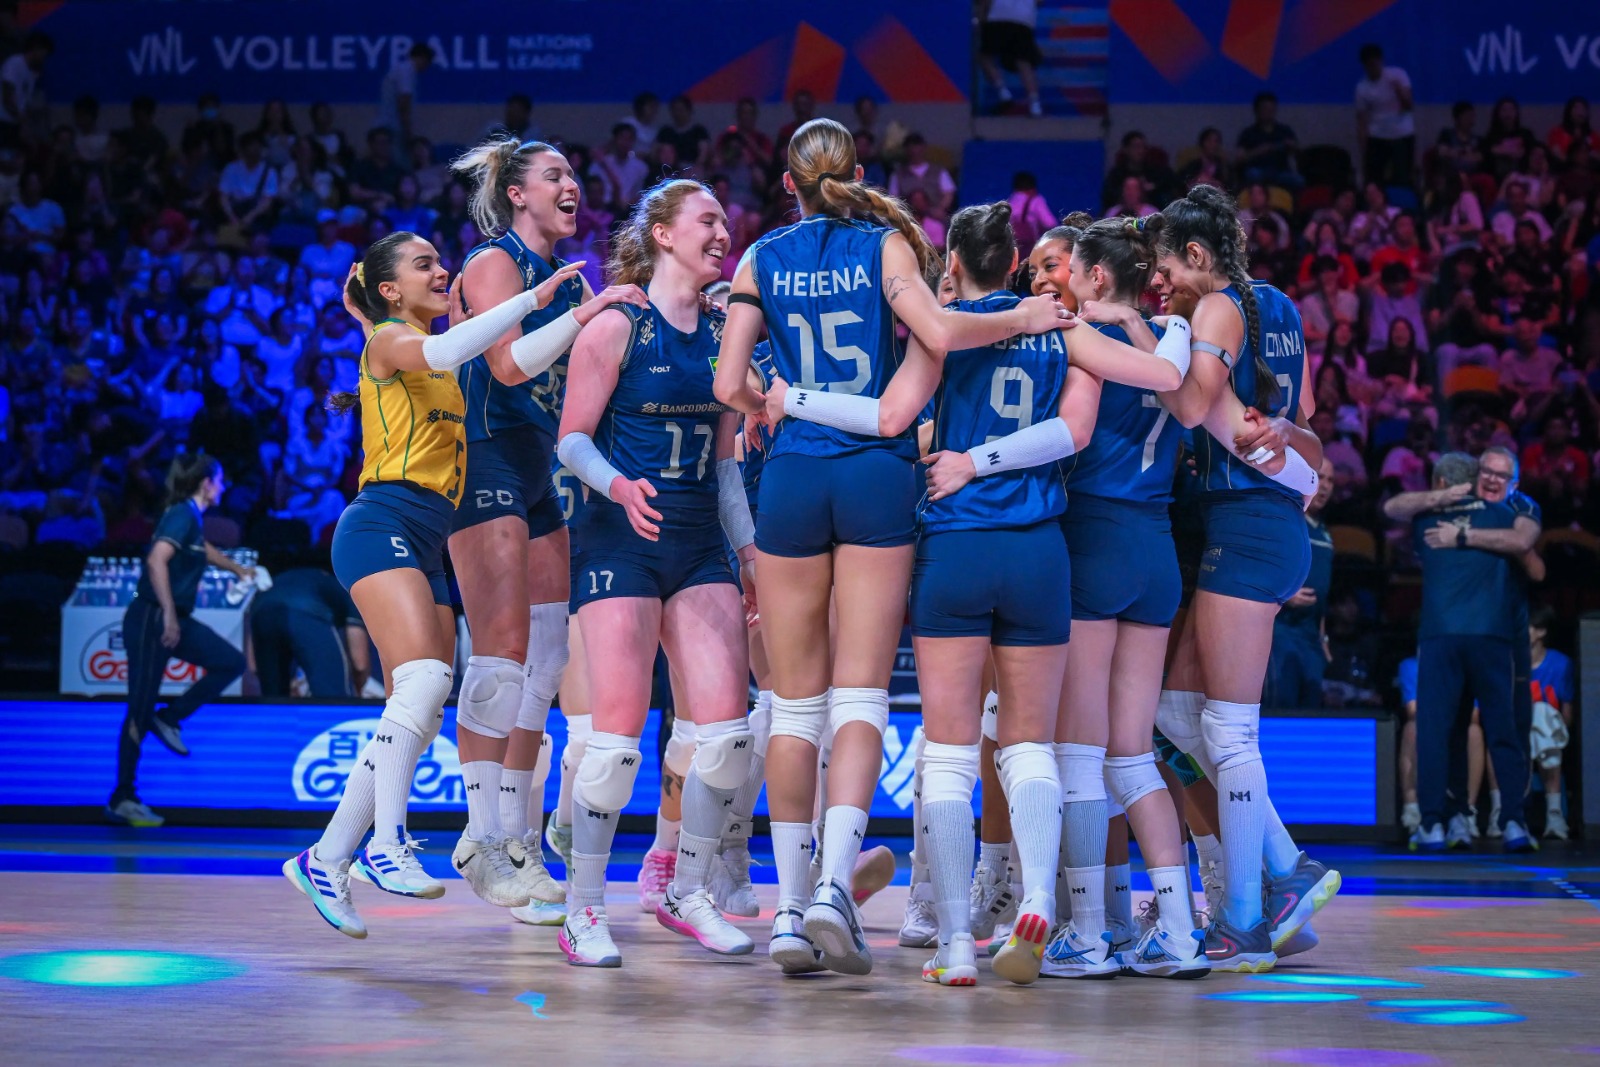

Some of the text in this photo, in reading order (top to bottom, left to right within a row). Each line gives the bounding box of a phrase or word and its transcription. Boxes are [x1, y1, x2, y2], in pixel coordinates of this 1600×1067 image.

[508, 35, 593, 50] NATIONS
[1464, 23, 1539, 75] VNL
[128, 26, 196, 75] VNL
[508, 54, 581, 70] LEAGUE
[772, 264, 872, 298] HELENA
[788, 310, 872, 396] 15
[990, 366, 1034, 431] 9
[660, 422, 714, 481] 17
[475, 489, 514, 509] 20
[390, 536, 409, 558] 5
[589, 570, 614, 594] 17
[376, 733, 393, 745] N1
[734, 740, 748, 750] N1
[363, 758, 376, 772] N
[621, 756, 636, 767] N1
[467, 782, 480, 792] N1
[500, 785, 517, 794] N1
[1229, 790, 1251, 802] N1
[680, 847, 697, 858] N1
[1071, 886, 1086, 895] N1
[1157, 886, 1173, 895] N1
